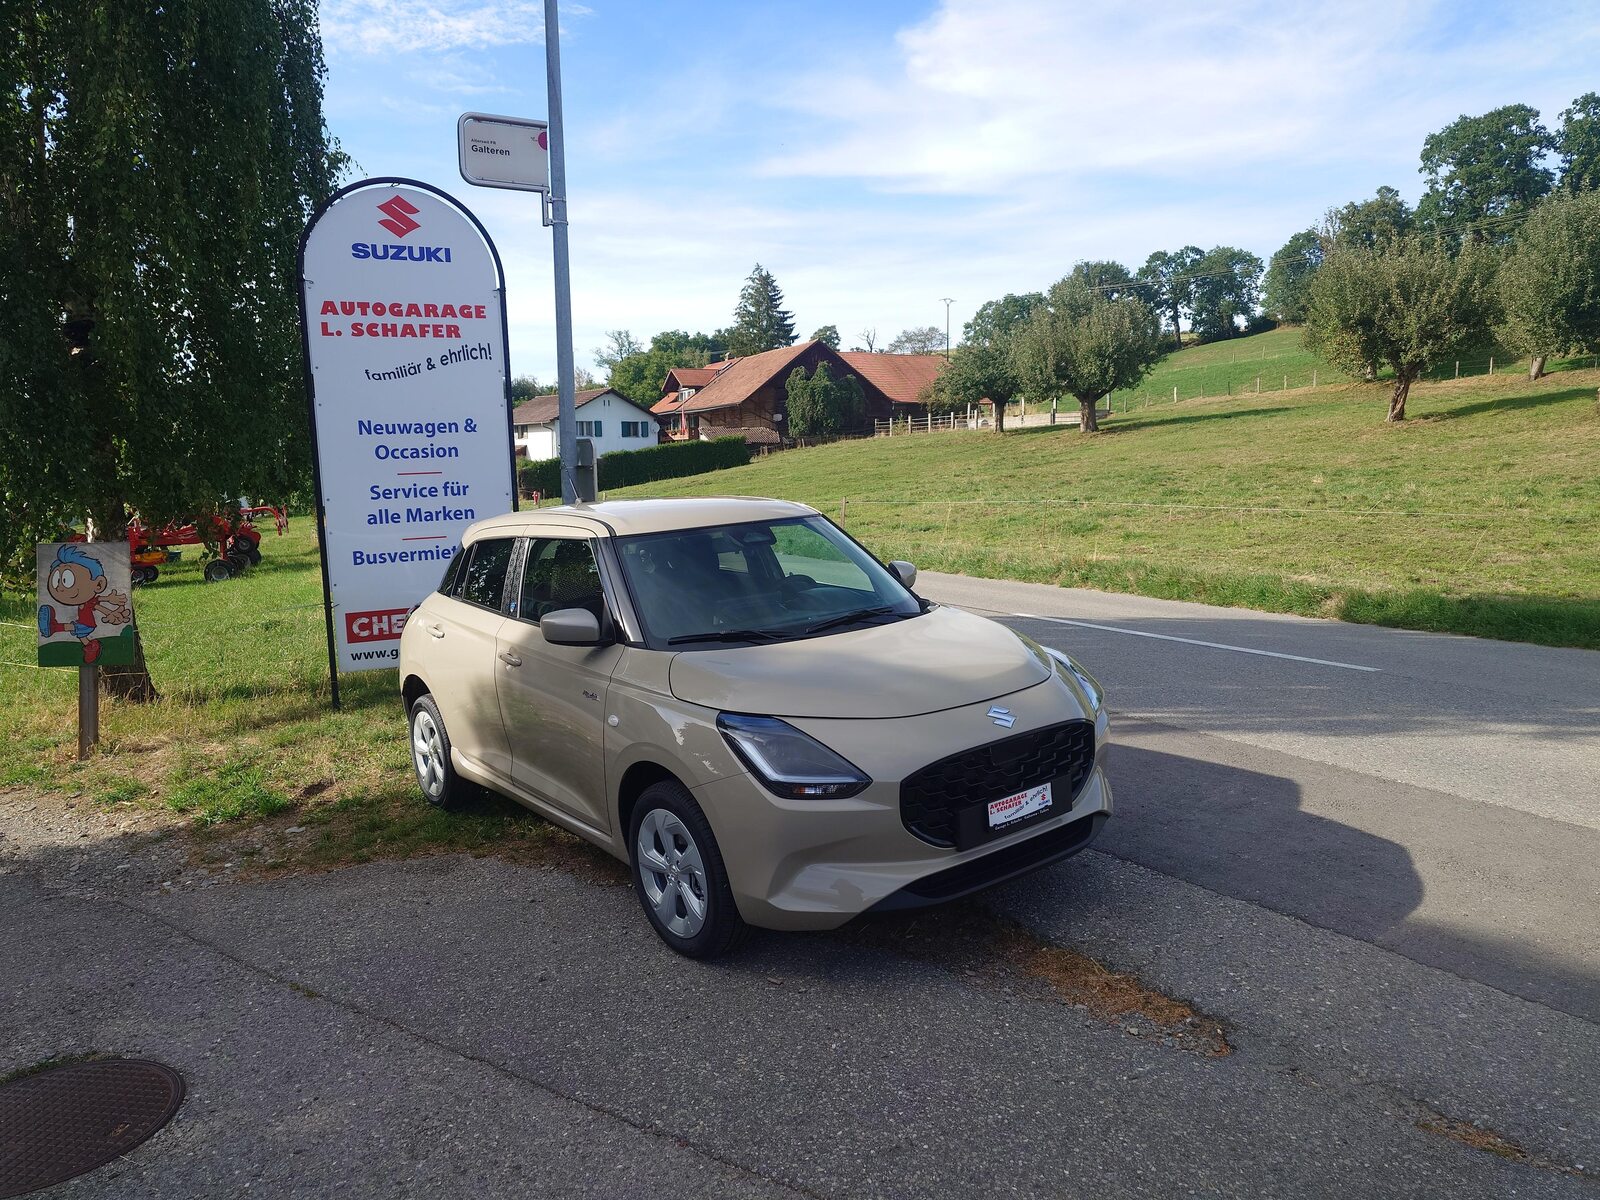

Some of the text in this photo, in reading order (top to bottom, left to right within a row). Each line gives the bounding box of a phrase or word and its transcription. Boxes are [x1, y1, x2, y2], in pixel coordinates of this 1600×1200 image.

[471, 144, 510, 156] Galteren
[351, 242, 452, 263] SUZUKI
[320, 300, 487, 319] AUTOGARAGE
[320, 322, 462, 339] L. SCHAFER
[364, 342, 493, 381] familiär & ehrlich!
[357, 417, 477, 438] Neuwagen &
[374, 443, 459, 460] Occasion
[369, 481, 470, 500] Service für
[367, 505, 475, 525] alle Marken
[350, 648, 401, 661] www.g
[989, 792, 1028, 809] AUTOGARAGE
